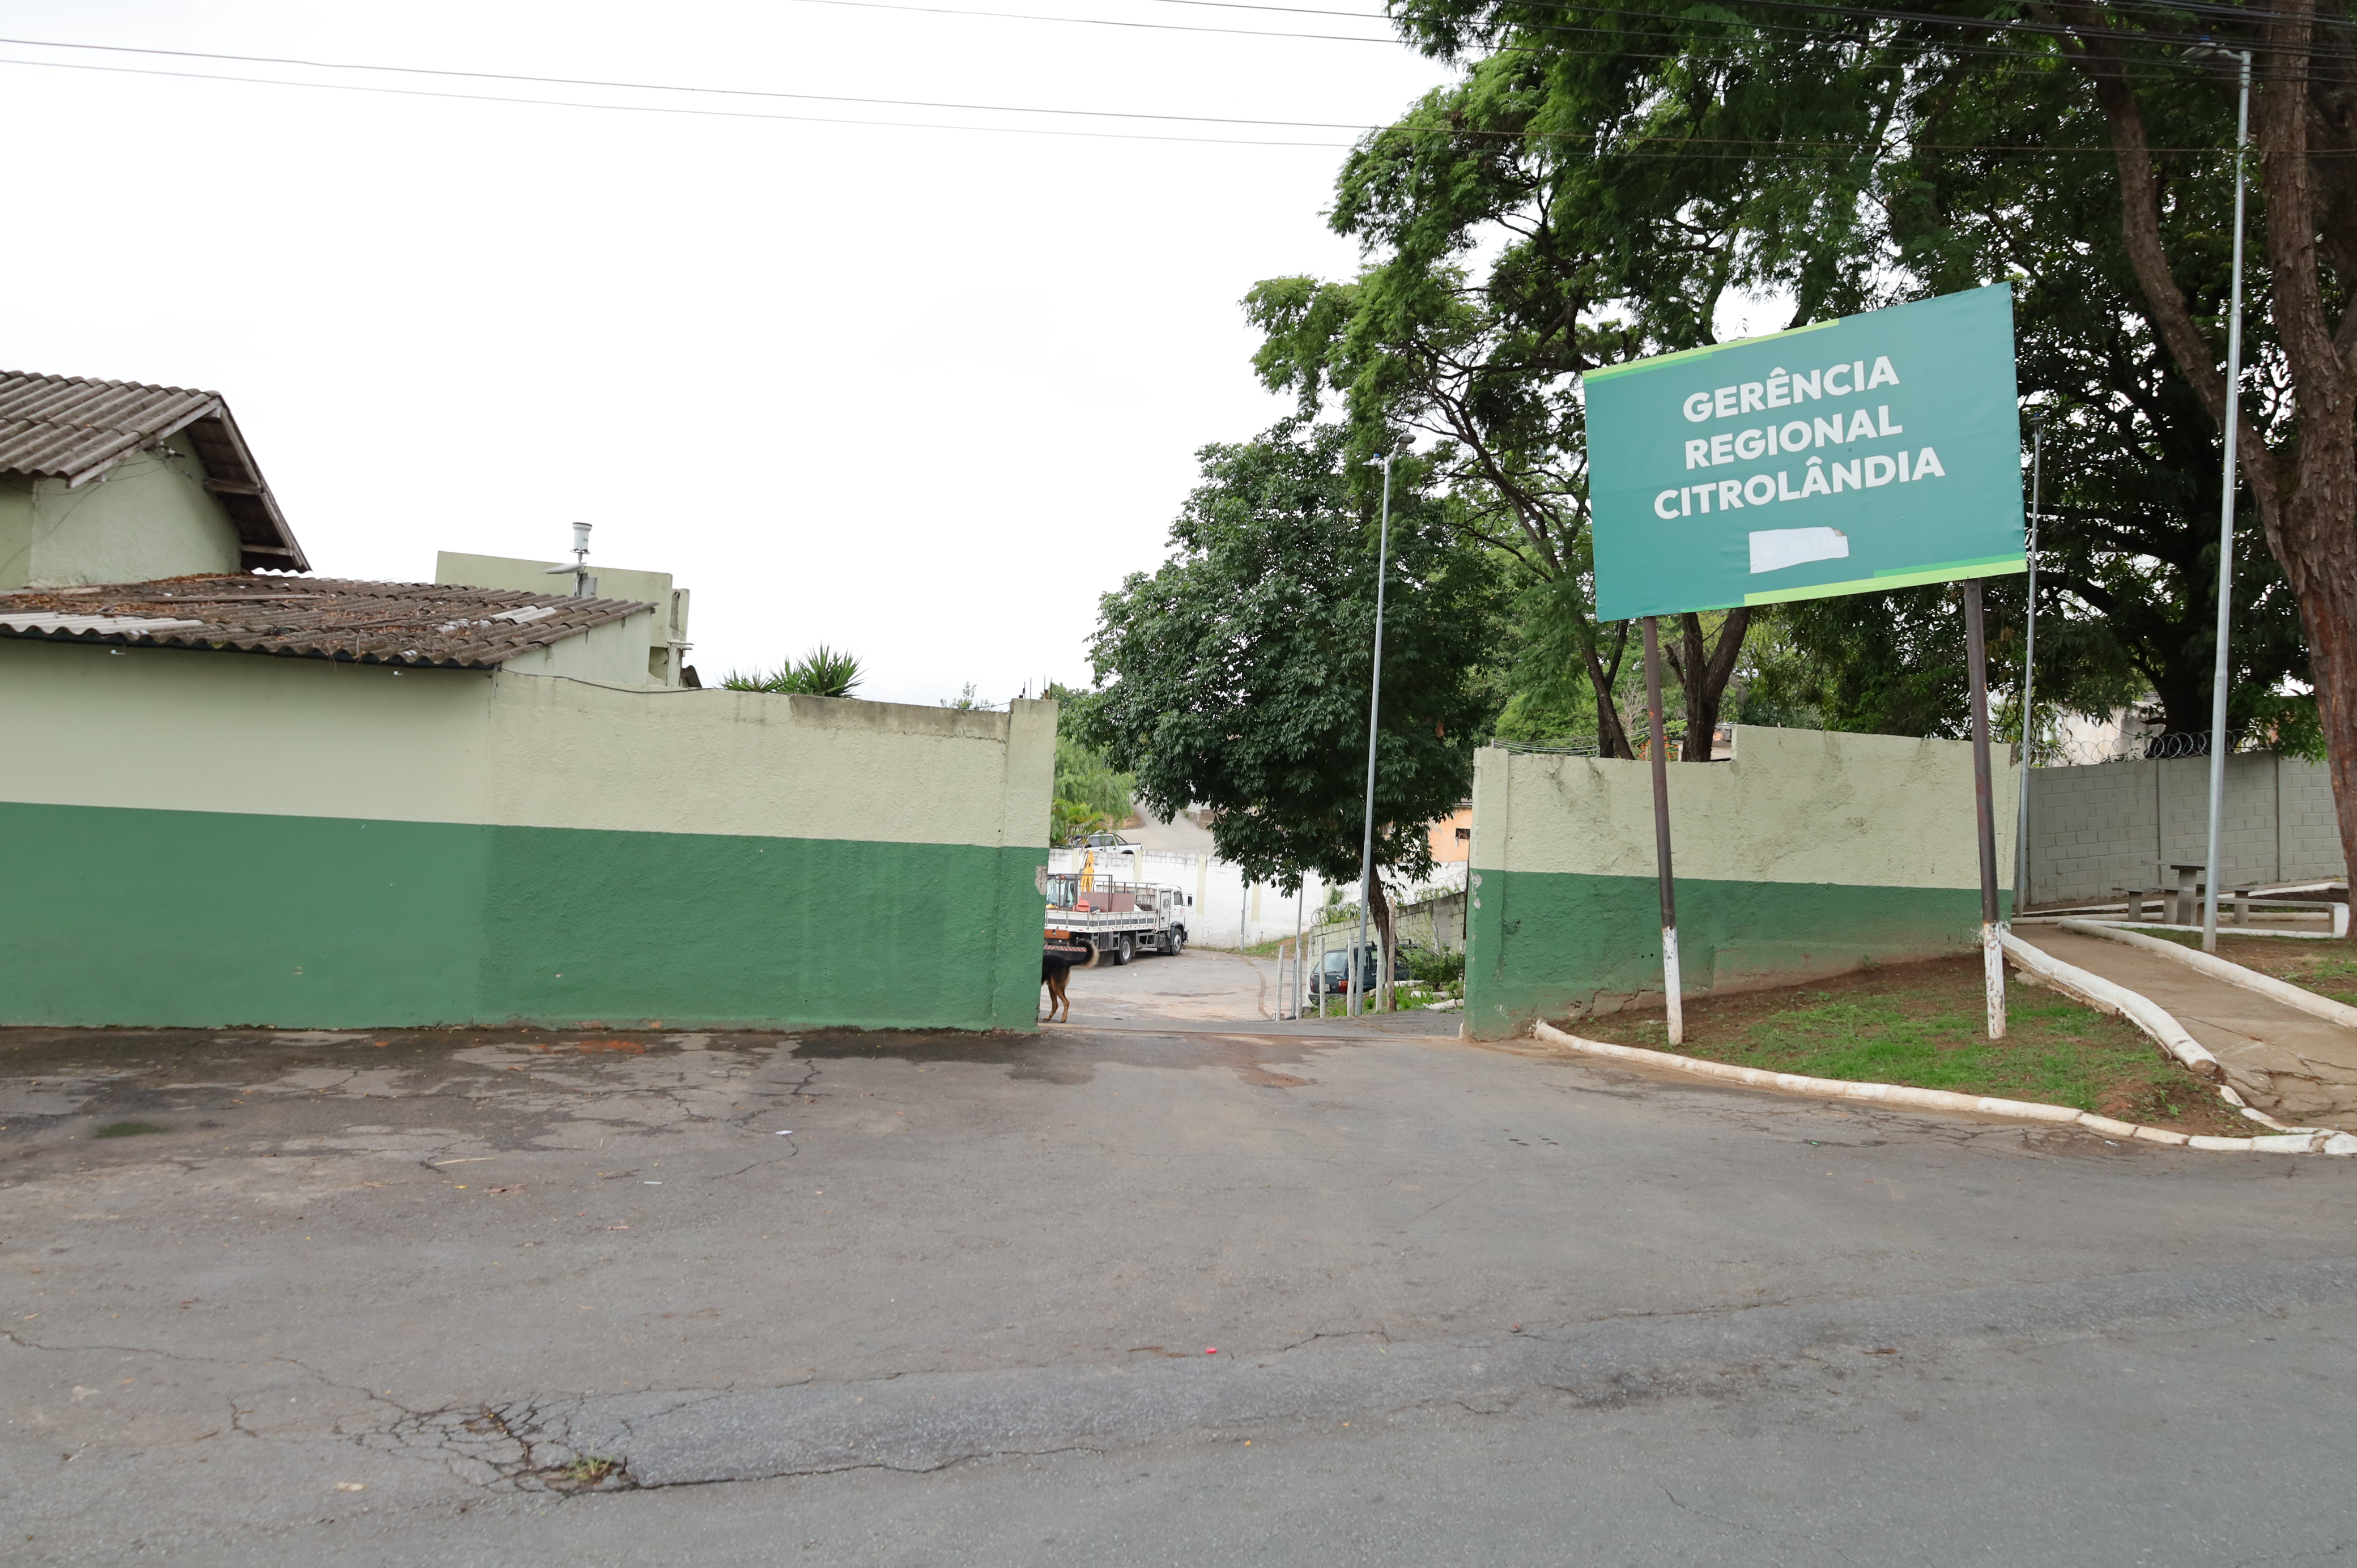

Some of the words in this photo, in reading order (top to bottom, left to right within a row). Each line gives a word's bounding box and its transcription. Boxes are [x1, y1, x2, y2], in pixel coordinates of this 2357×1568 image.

[1682, 355, 1900, 423] GERÊNCIA
[1685, 404, 1903, 470] REGIONAL
[1654, 446, 1946, 519] CITROLÂNDIA
